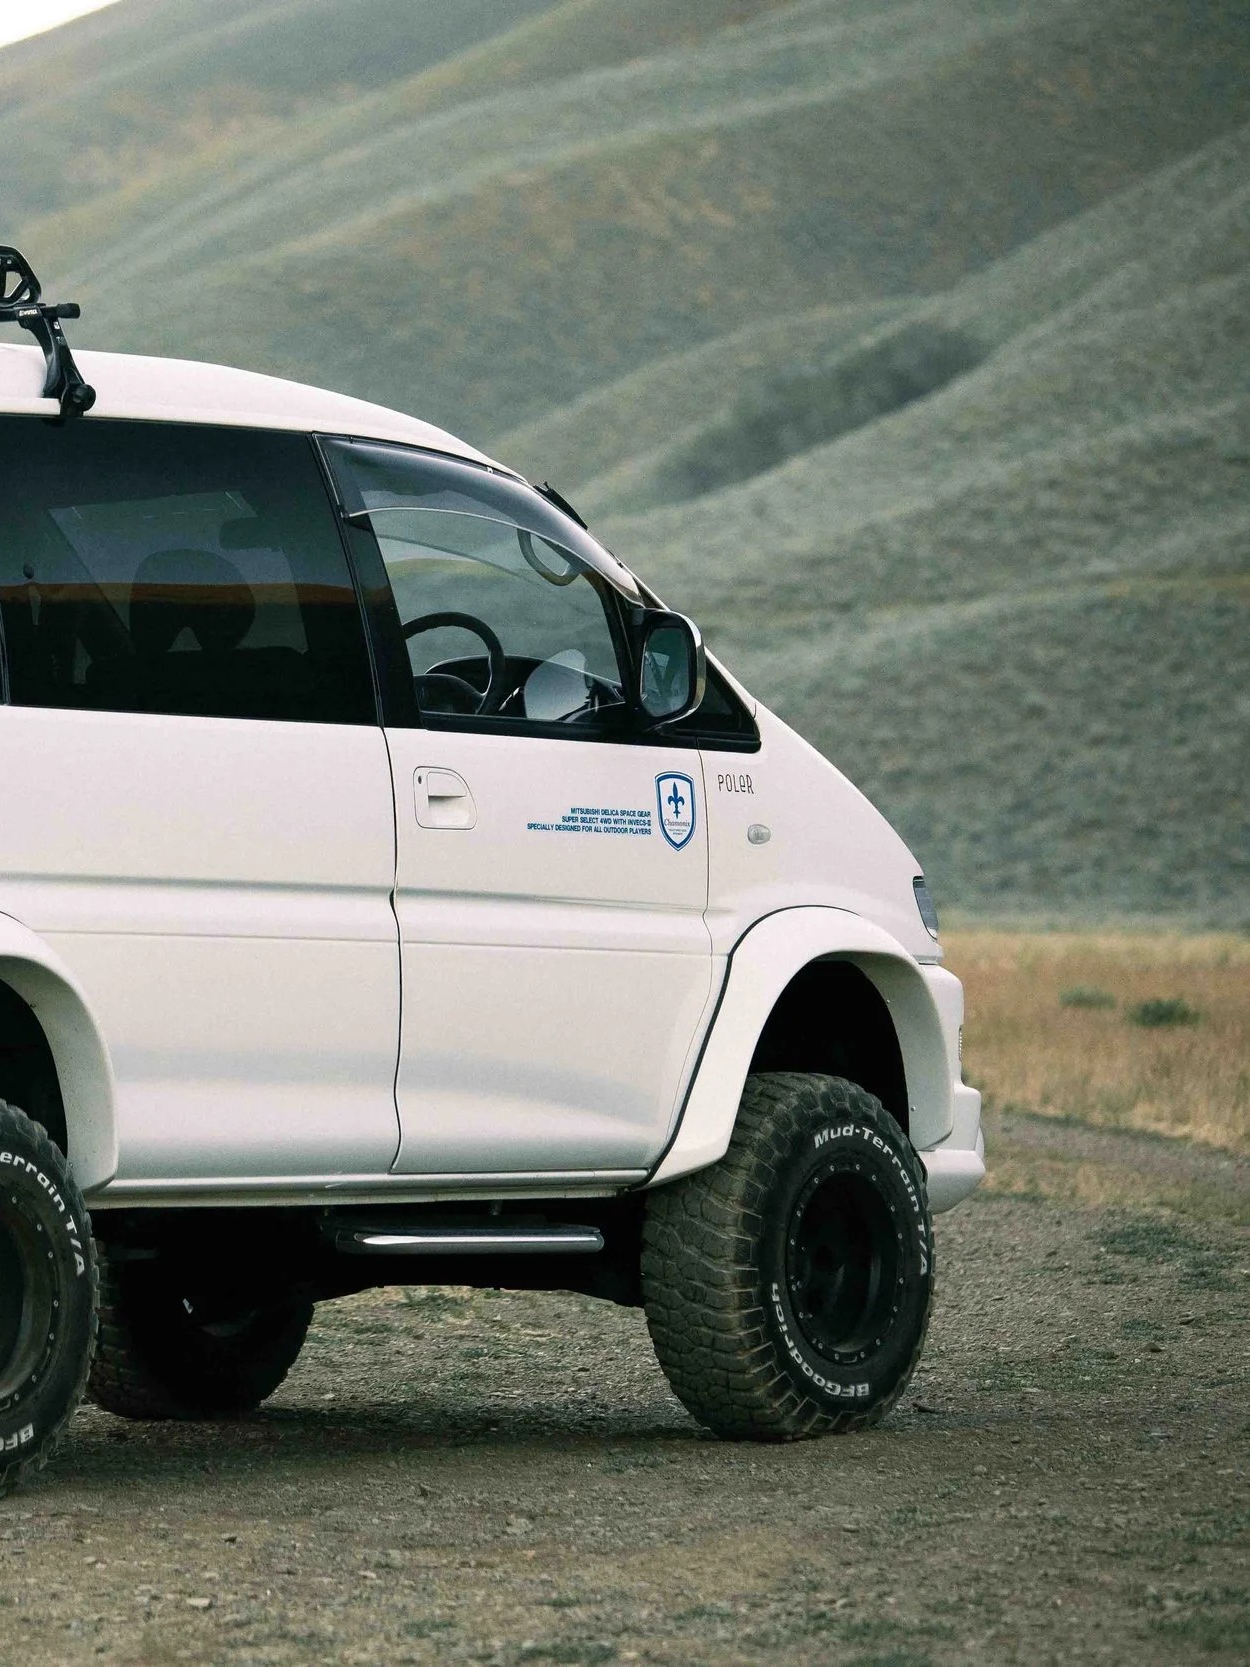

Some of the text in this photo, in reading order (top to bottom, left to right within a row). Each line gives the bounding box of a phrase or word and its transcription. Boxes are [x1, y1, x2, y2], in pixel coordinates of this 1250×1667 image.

[570, 807, 600, 815] MITSUBISHI
[637, 810, 651, 818] GEAR
[561, 815, 579, 823] SUPER
[580, 816, 598, 824] SELECT
[600, 817, 612, 825] 4WD
[664, 818, 690, 828] Chamonix
[527, 822, 554, 831] SPECIALLY
[555, 824, 581, 832] DESIGNED
[603, 826, 628, 834] OUTDOOR
[629, 827, 652, 835] PLAYERS
[814, 1123, 928, 1276] Mud-Terrain T/A
[65, 1214, 86, 1277] T/A
[771, 1282, 870, 1397] BFGoodrich
